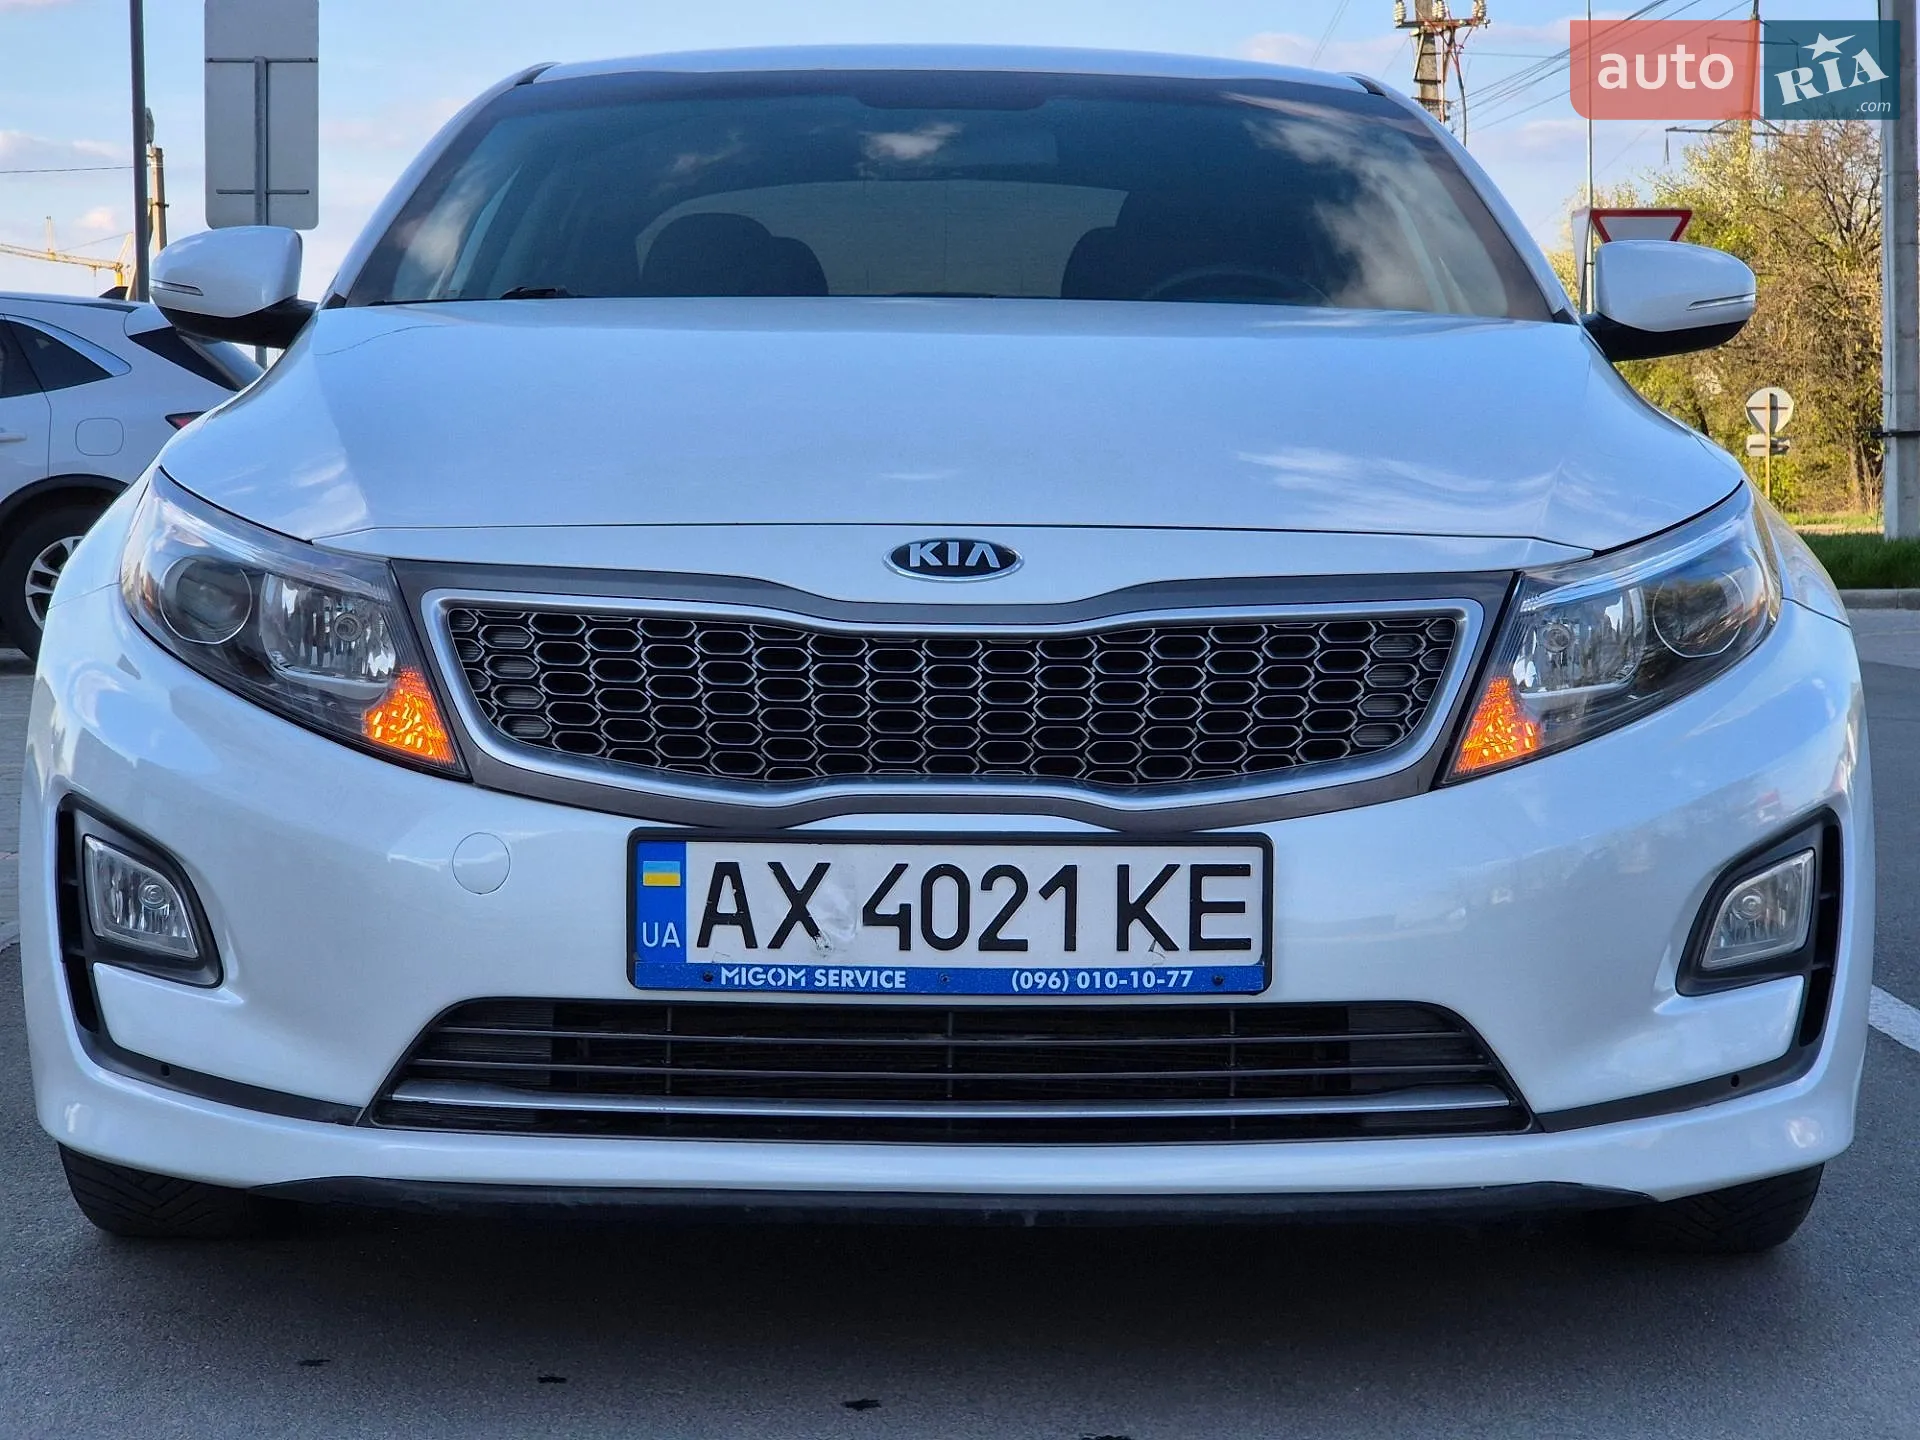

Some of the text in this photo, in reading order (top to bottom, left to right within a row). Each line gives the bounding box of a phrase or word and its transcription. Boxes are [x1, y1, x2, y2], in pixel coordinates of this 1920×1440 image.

[908, 541, 1001, 568] KIA
[696, 861, 1251, 951] AX 4021 KE
[642, 921, 681, 948] UA
[720, 966, 906, 989] MIGOM SERVICE
[1011, 970, 1194, 992] (096) 010-10-77
